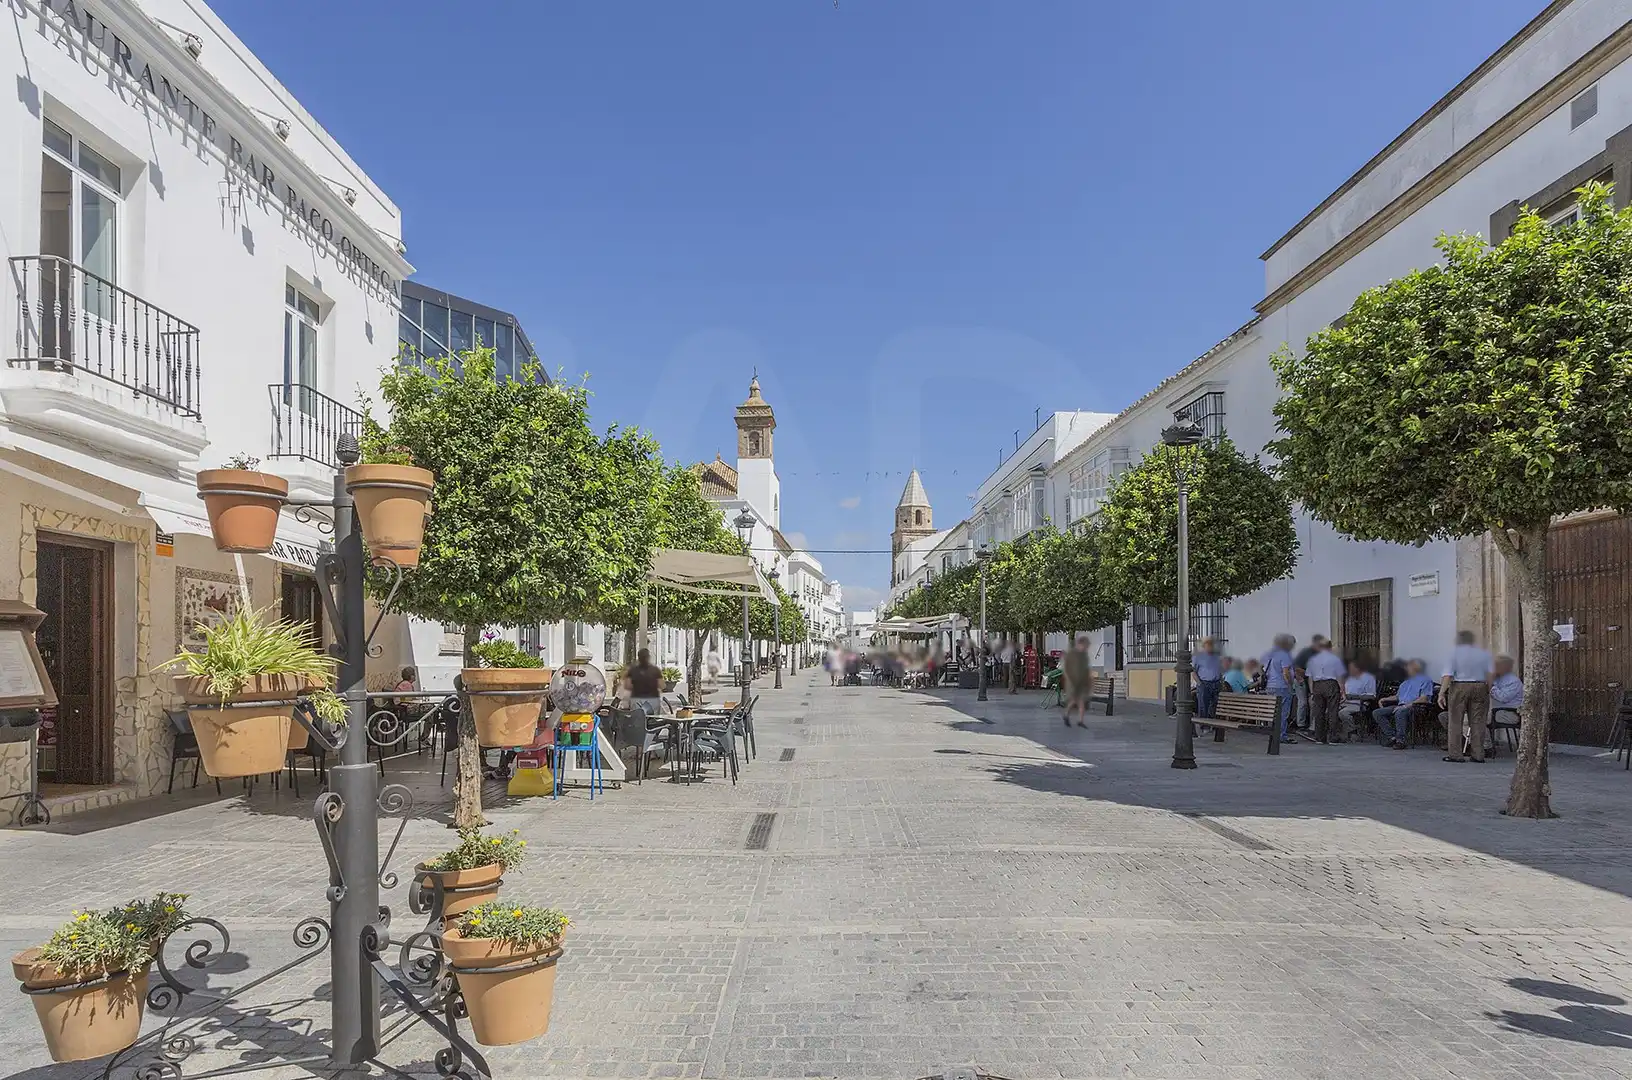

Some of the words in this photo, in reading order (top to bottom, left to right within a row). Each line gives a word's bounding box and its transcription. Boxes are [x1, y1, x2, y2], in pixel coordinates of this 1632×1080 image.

[228, 133, 275, 194] BAR
[286, 184, 333, 241] PACO
[340, 236, 401, 300] ORTEGA
[286, 545, 317, 567] PACO
